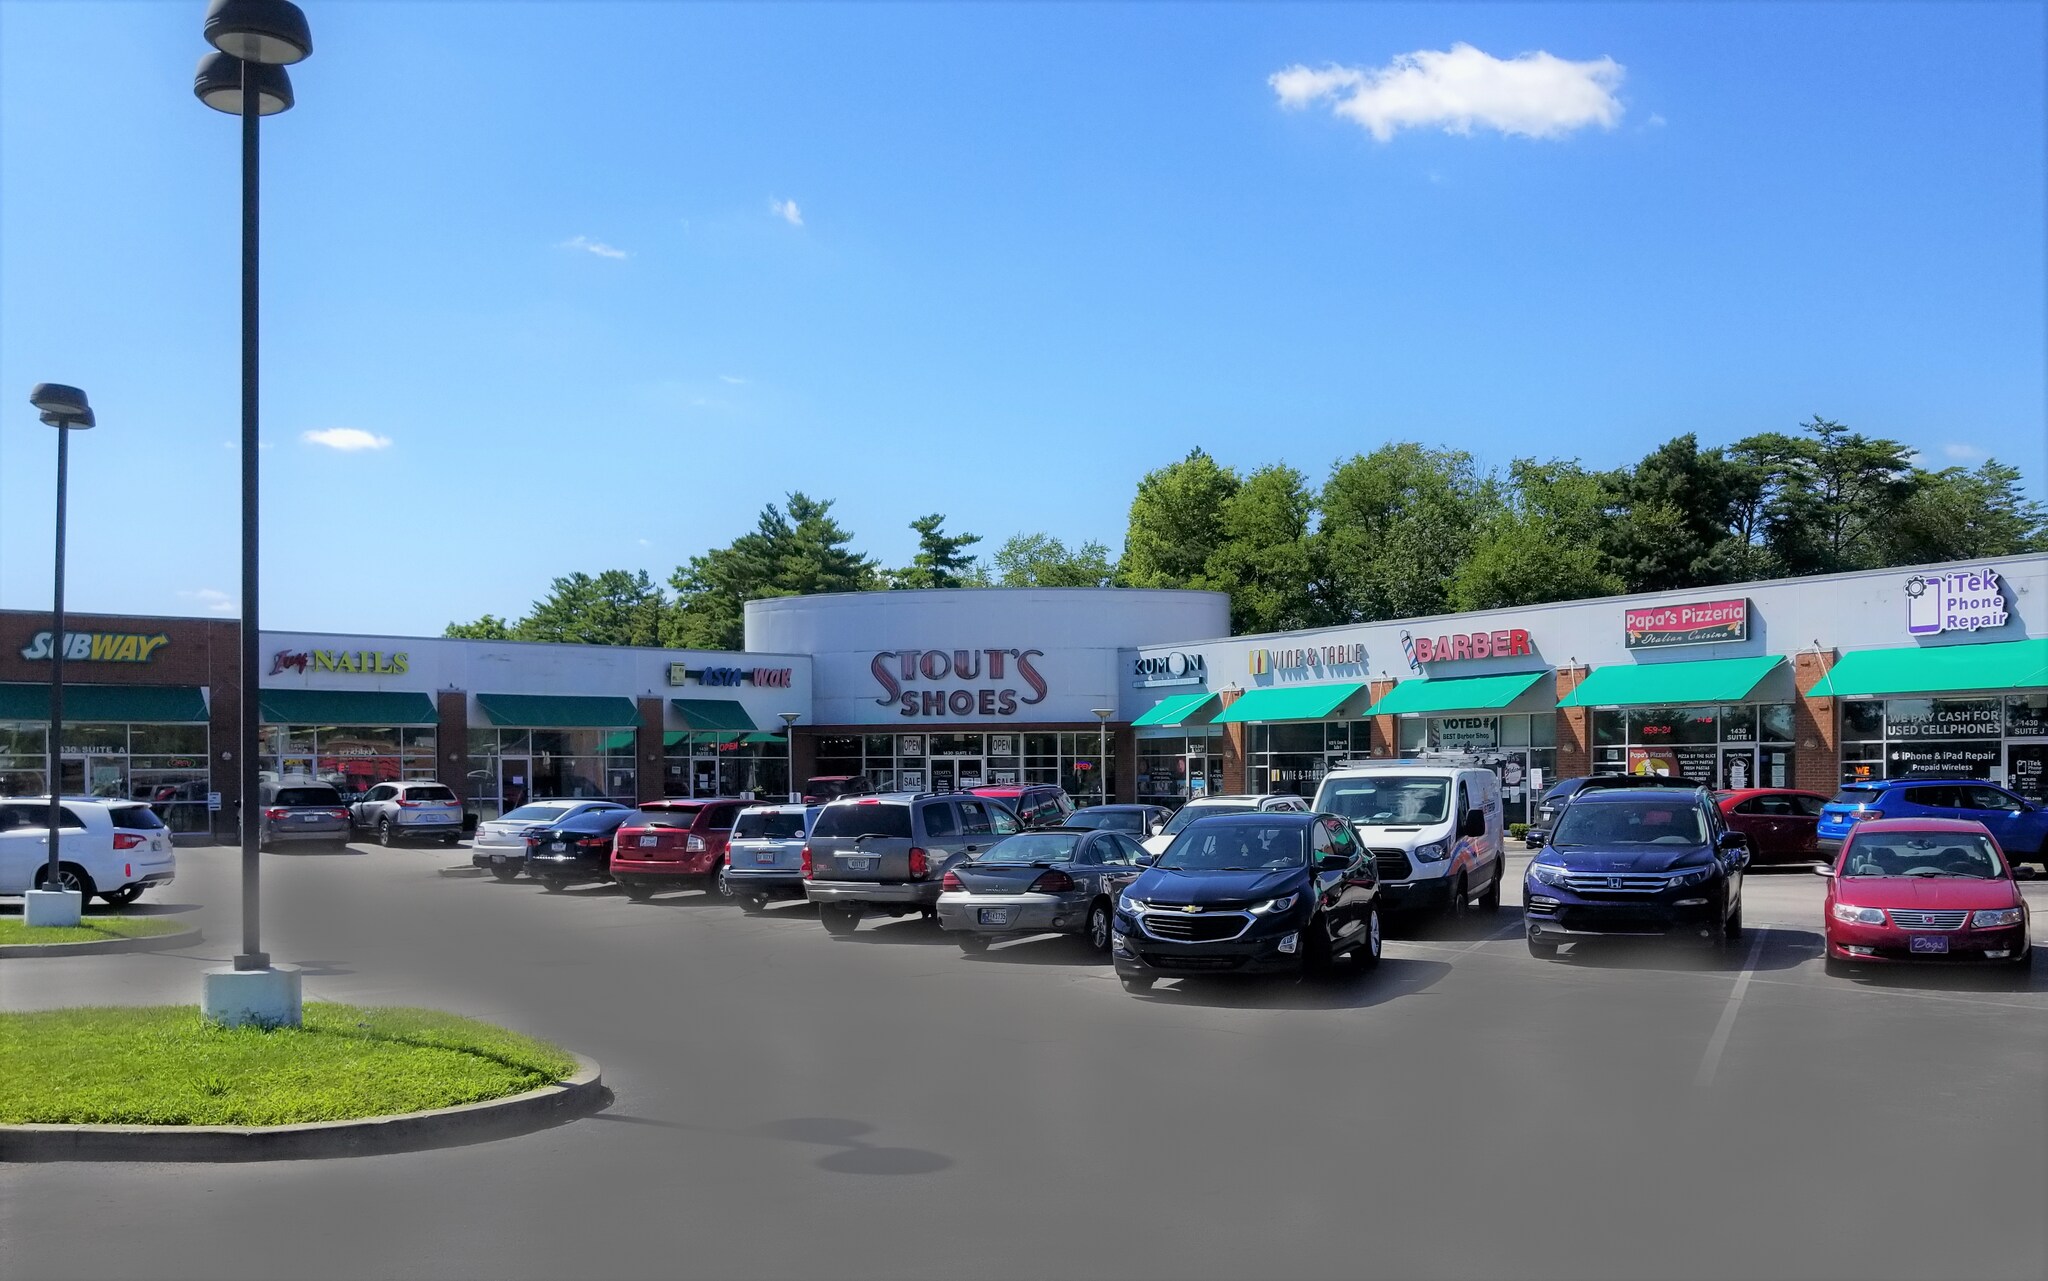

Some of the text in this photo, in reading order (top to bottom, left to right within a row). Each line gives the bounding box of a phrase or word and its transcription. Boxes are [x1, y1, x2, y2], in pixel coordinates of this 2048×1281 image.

[1947, 569, 1999, 594] iTek
[1947, 598, 2003, 611] Phone
[1626, 604, 1744, 631] Papa's Pizzeria
[1946, 612, 2006, 631] Repair
[1641, 630, 1728, 645] Italian Cuisine
[1415, 629, 1531, 663] BARBER
[312, 649, 410, 675] NAILS
[1273, 643, 1361, 669] VINE & TABLE
[1135, 651, 1202, 676] KUMON
[698, 666, 792, 688] ASIA WOK
[870, 648, 1048, 706] STOUT'S
[900, 688, 1018, 716] SHOES
[1443, 717, 1482, 729] VOTED
[1890, 710, 1999, 723] WE PAY CASH FOR
[1476, 732, 1489, 740] Shop
[1888, 723, 2001, 736] USED CELLPHONES
[720, 741, 738, 752] OPEN
[904, 740, 920, 750] OPEN
[993, 740, 1011, 750] OPEN
[1902, 751, 1996, 762] iPhone & iPad Repair
[1856, 766, 1870, 775] WE
[1912, 763, 1973, 772] Prepaid Wireless
[904, 777, 920, 787] SALE
[1914, 937, 1944, 952] Dogs
